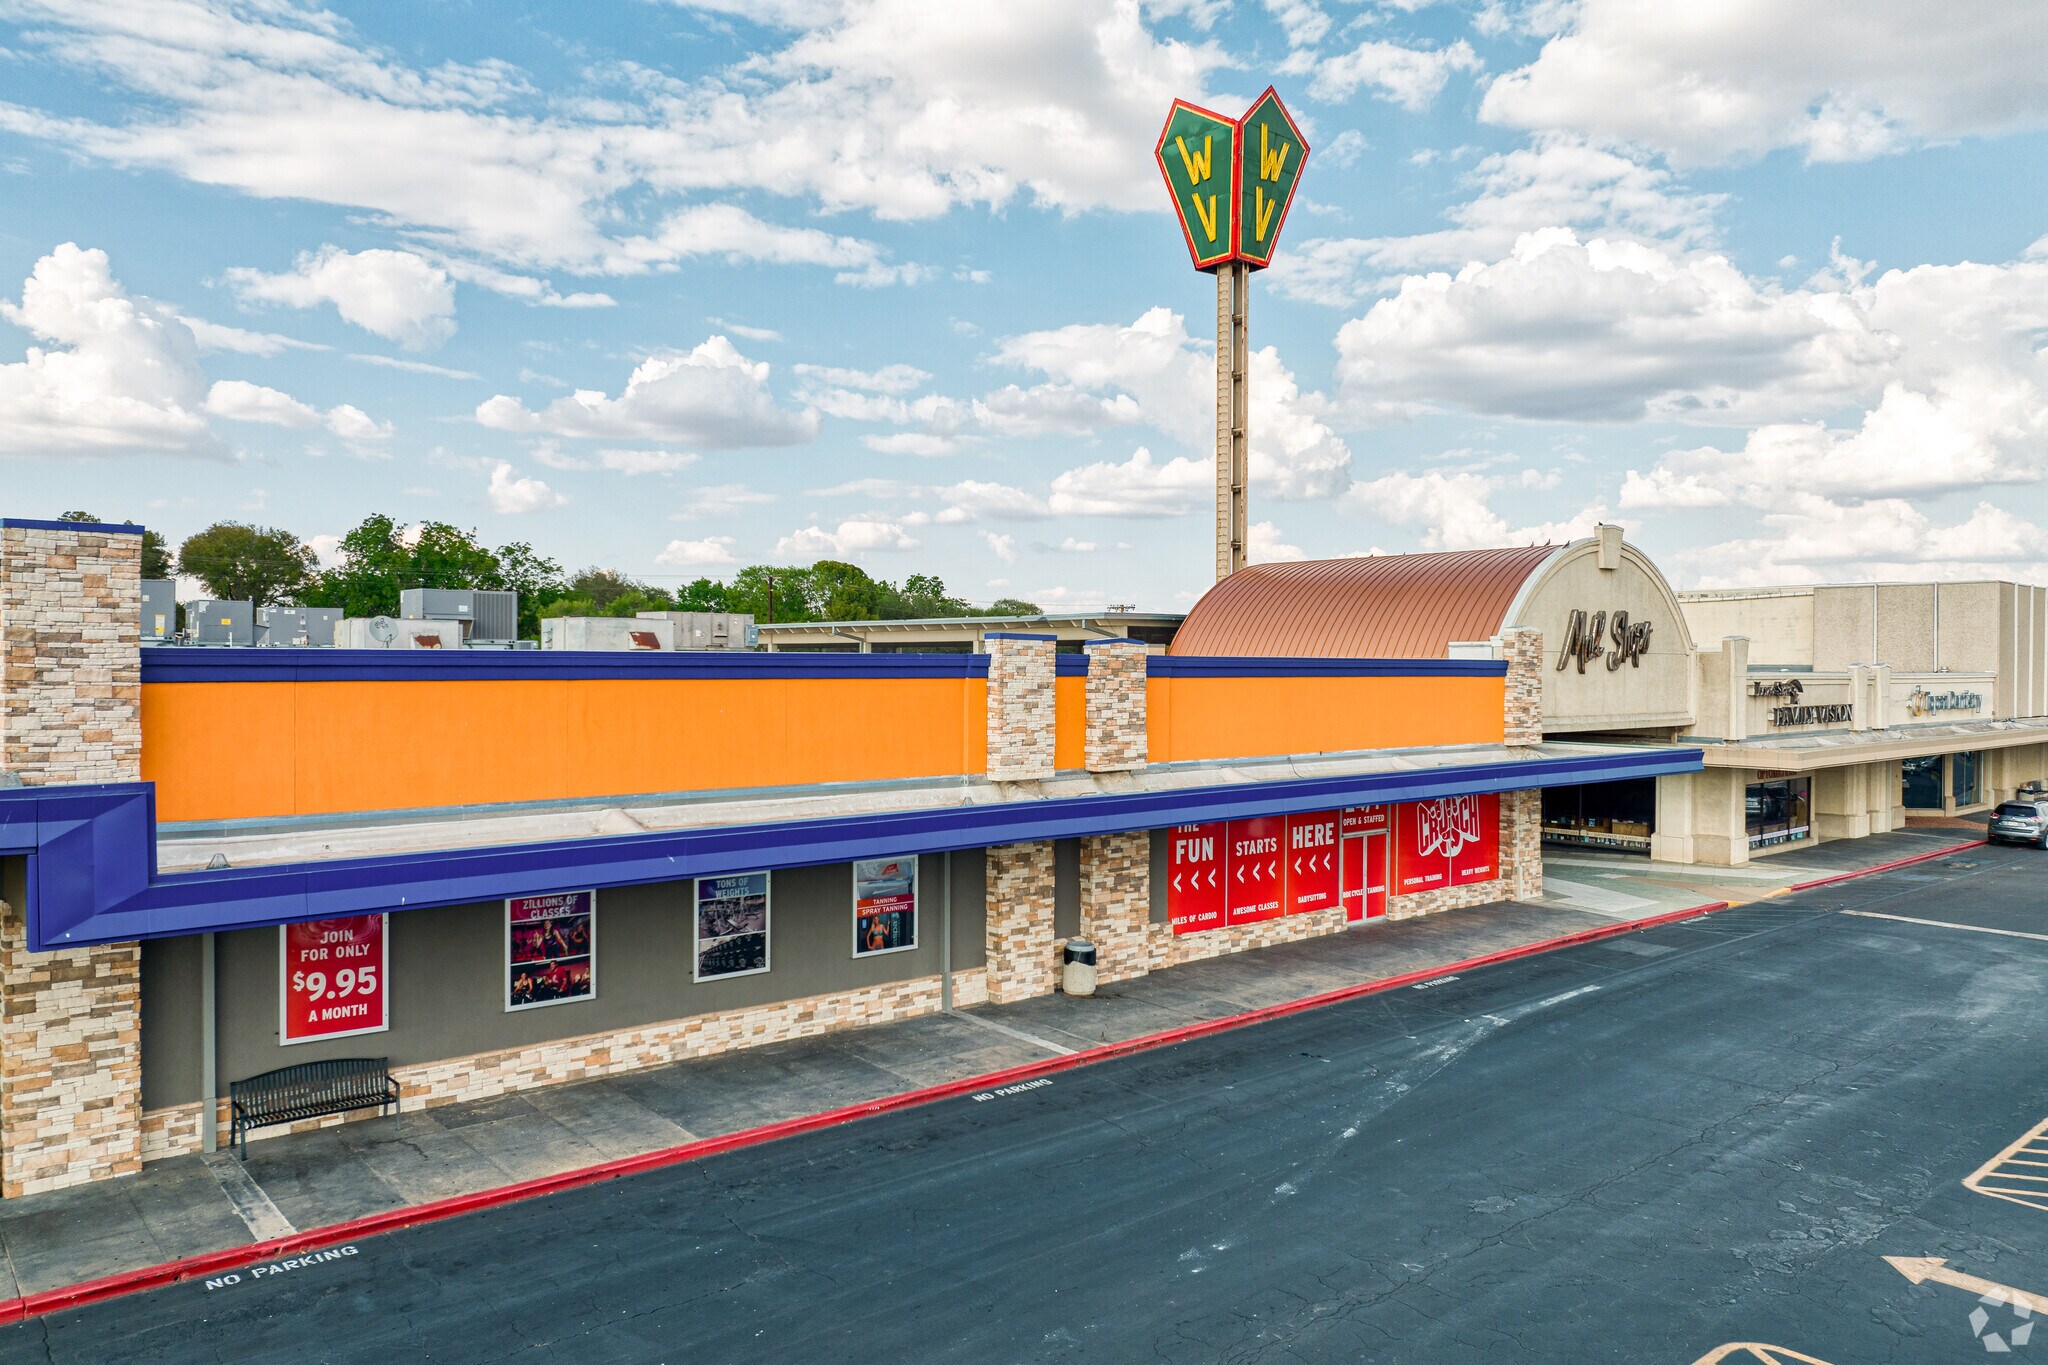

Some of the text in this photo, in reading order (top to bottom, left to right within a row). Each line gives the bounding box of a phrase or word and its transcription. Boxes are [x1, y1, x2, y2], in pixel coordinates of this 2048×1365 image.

[1174, 135, 1213, 186] W
[1260, 122, 1291, 183] W
[1191, 192, 1217, 243] V
[1255, 185, 1276, 242] V
[1343, 814, 1385, 826] OPEN & STAFFED
[1416, 795, 1480, 857] CRUNCH
[1292, 822, 1334, 849] HERE
[1176, 837, 1214, 864] FUN
[1236, 837, 1277, 857] STARTS
[715, 877, 750, 889] TONS OF
[715, 886, 750, 898] WEIGHTS
[523, 895, 578, 910] ZILLIONS OF
[873, 897, 897, 905] TANNING
[1297, 892, 1327, 904] BABYSITTING
[530, 906, 572, 919] CLASSES
[862, 904, 908, 915] SPRAY TANNING
[1232, 901, 1279, 915] AWESOME CLASSES
[1171, 911, 1217, 925] MILES OF CARDIO
[320, 929, 354, 944] JOIN
[301, 944, 370, 962] FOR ONLY
[293, 966, 377, 1002] $9.95
[308, 1003, 368, 1023] A MONTH
[972, 1078, 1053, 1102] NO PARKING
[205, 1246, 360, 1291] NO PARKING
